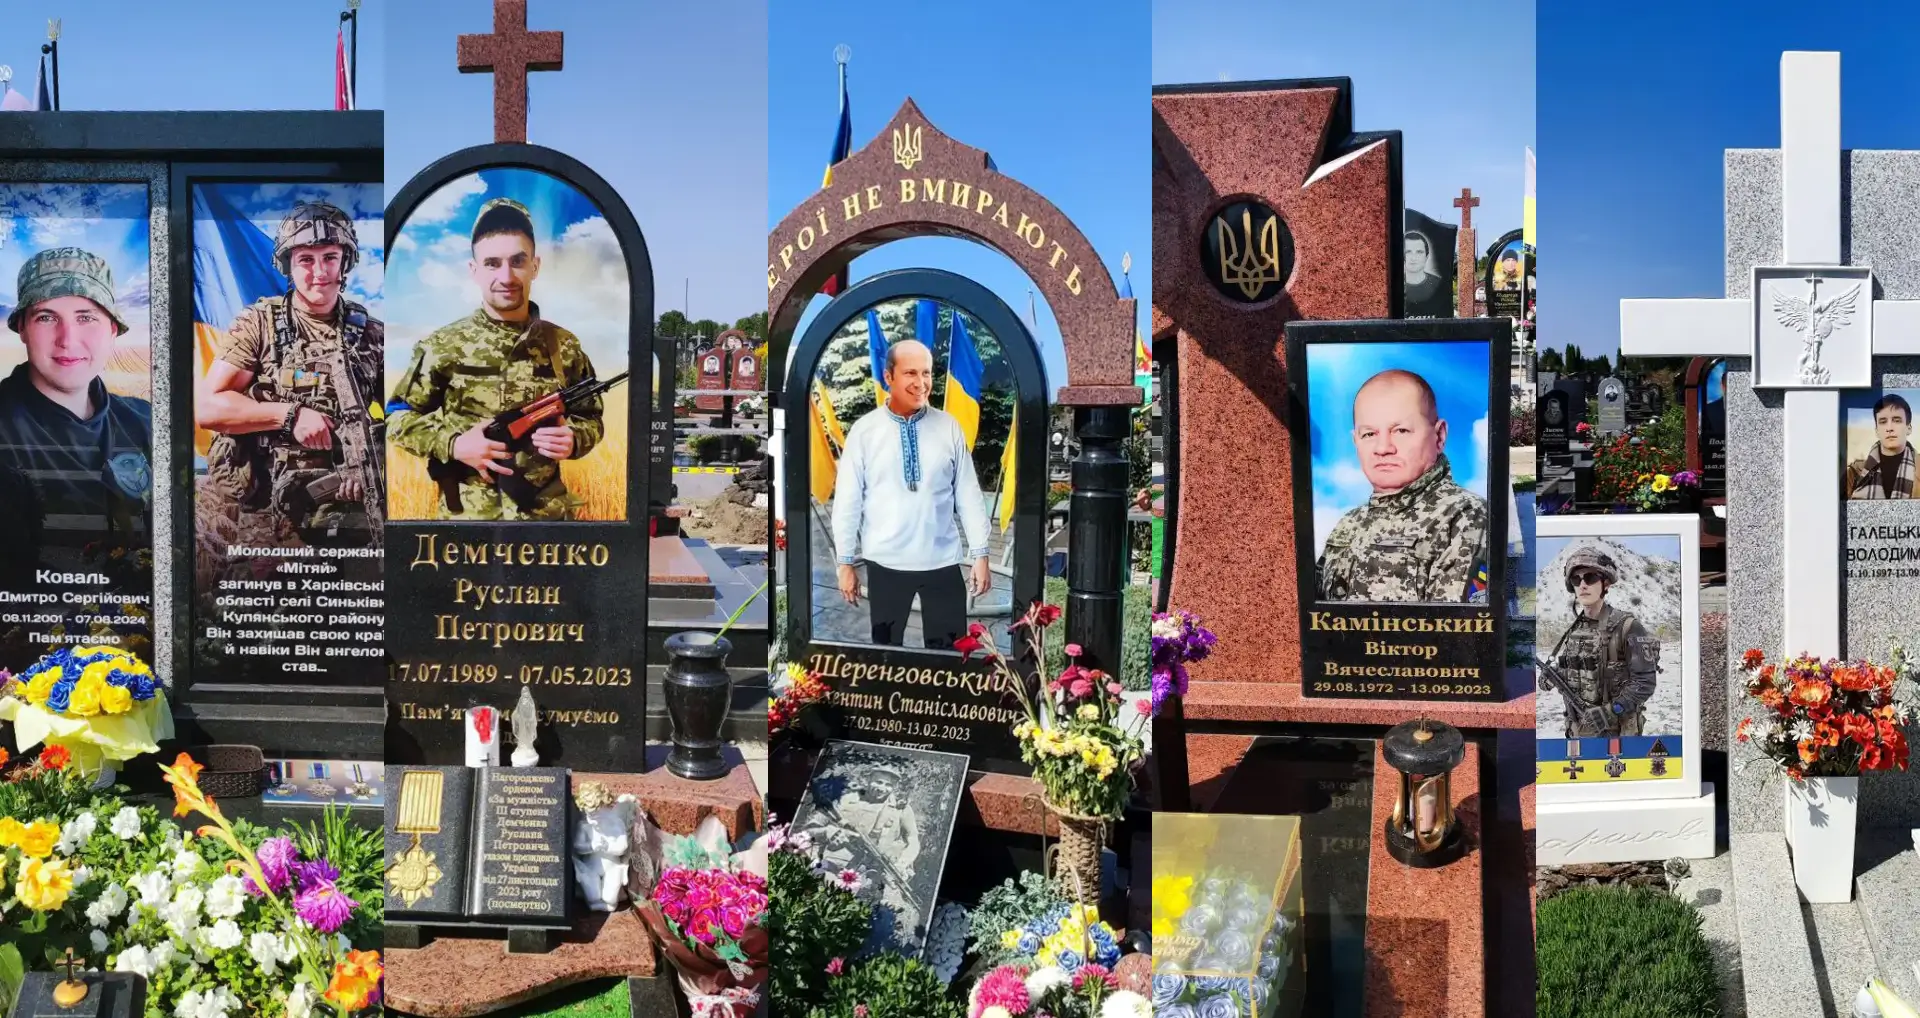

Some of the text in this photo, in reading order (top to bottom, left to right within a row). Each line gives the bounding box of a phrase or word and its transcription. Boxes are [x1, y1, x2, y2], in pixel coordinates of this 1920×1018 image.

[841, 184, 883, 221] НЕ
[900, 178, 1083, 296] ВМИРАЮТЬ
[228, 545, 384, 559] Молодший сержант
[410, 533, 610, 571] Демченко
[276, 562, 337, 574] «Мітяй»
[36, 570, 110, 584] Коваль
[219, 579, 384, 592] загинув в Харківські
[0, 591, 150, 605] Дмитро Сергійович
[453, 577, 561, 610] Руслан
[216, 595, 274, 606] області
[279, 596, 311, 607] селі
[2, 614, 63, 623] 08.11.2001
[75, 615, 147, 625] 07.08.2024
[223, 611, 384, 626] Купянського району
[1309, 611, 1494, 633] Камінський
[206, 627, 231, 638] Він
[236, 630, 305, 641] захищав
[310, 631, 350, 640] свою
[434, 614, 584, 648] Петрович
[225, 644, 235, 655] й
[239, 645, 290, 656] навіки
[295, 645, 320, 656] Він
[1364, 641, 1438, 659] Віктор
[388, 662, 498, 683] 17.07.1989
[519, 664, 632, 687] 07.05.2023
[810, 653, 1008, 696] Шеренговський
[1324, 661, 1480, 678] Вячеславович
[1314, 682, 1394, 693] 29.08.1972
[1411, 683, 1491, 695] 13.09.2023
[889, 691, 1018, 724] Станіславович
[491, 772, 556, 785] Нагороджено
[503, 785, 544, 795] орденом
[488, 794, 558, 806] «За мужність»
[510, 808, 549, 817] ступеня
[496, 817, 548, 828] Демченка
[501, 828, 543, 840] Руслана
[493, 839, 550, 852] Петровича
[512, 854, 560, 864] президента
[501, 862, 540, 874] України
[497, 875, 508, 884] 27
[508, 876, 559, 887] листопада
[498, 887, 543, 899] 2023 року
[487, 898, 551, 912] (посмертно)
